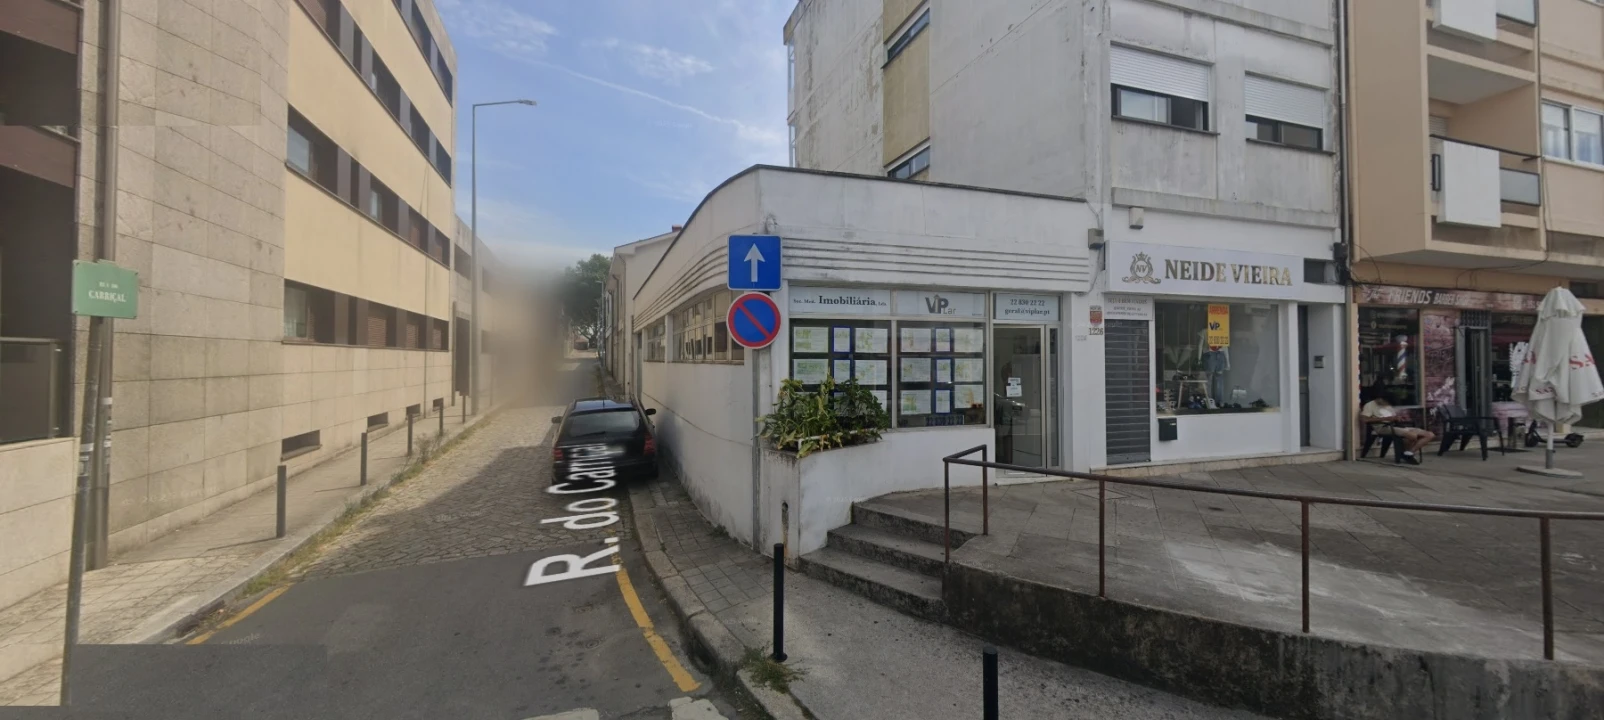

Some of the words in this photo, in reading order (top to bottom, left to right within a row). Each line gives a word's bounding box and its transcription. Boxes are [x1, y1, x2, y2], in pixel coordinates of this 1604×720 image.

[1164, 259, 1226, 283] NEIDE
[1231, 263, 1293, 286] VIEIRA
[88, 290, 126, 303] CARRIÇAL
[1388, 289, 1432, 305] FRIENDS
[943, 306, 957, 315] Lar
[1088, 327, 1104, 336] 1226
